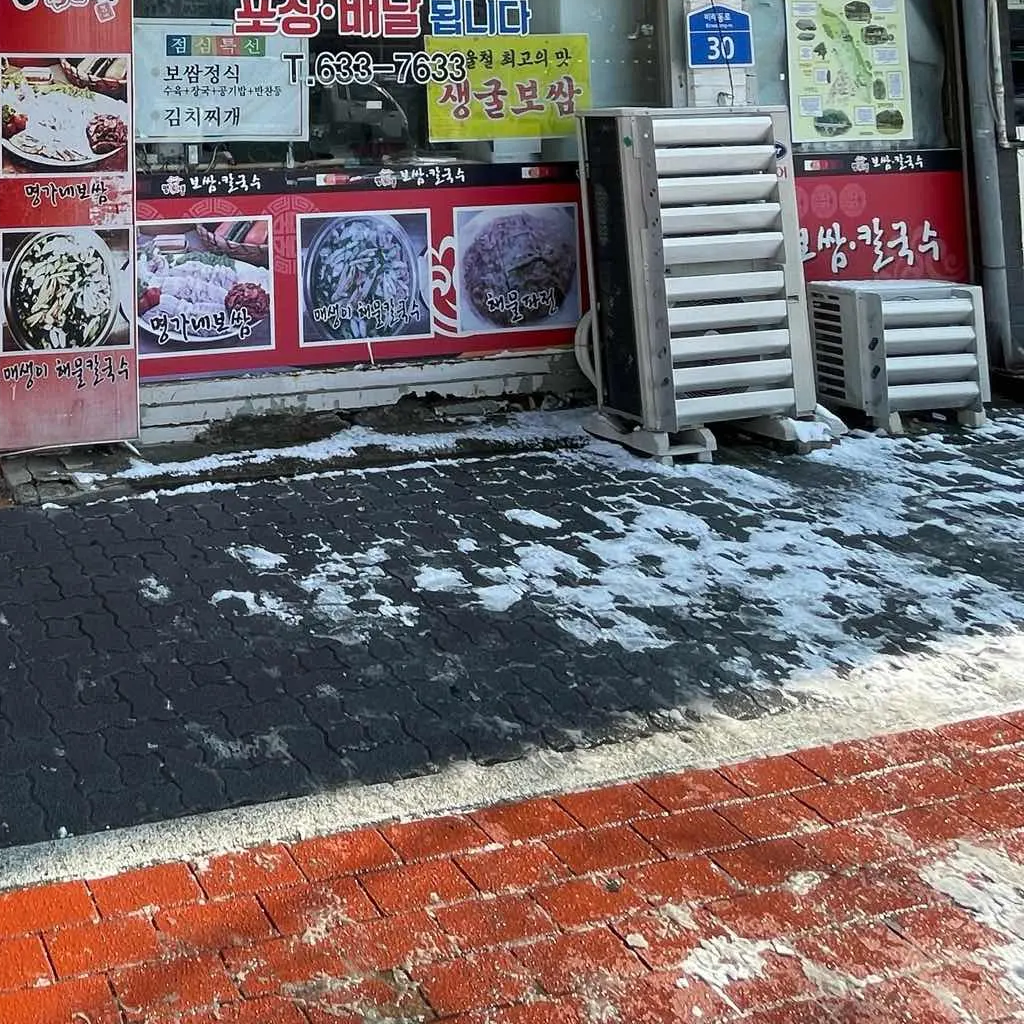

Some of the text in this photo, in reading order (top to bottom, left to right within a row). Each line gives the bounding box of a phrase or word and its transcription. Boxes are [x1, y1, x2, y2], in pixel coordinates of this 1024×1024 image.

[170, 36, 261, 55] 점심특선
[707, 36, 735, 60] 30
[500, 47, 549, 68] 최고의
[554, 47, 573, 69] 맛
[163, 63, 240, 85] 보쌈정식
[438, 75, 583, 120] 생굴보쌈
[163, 106, 241, 127] 김치찌개
[150, 306, 254, 344] 명가네보쌈
